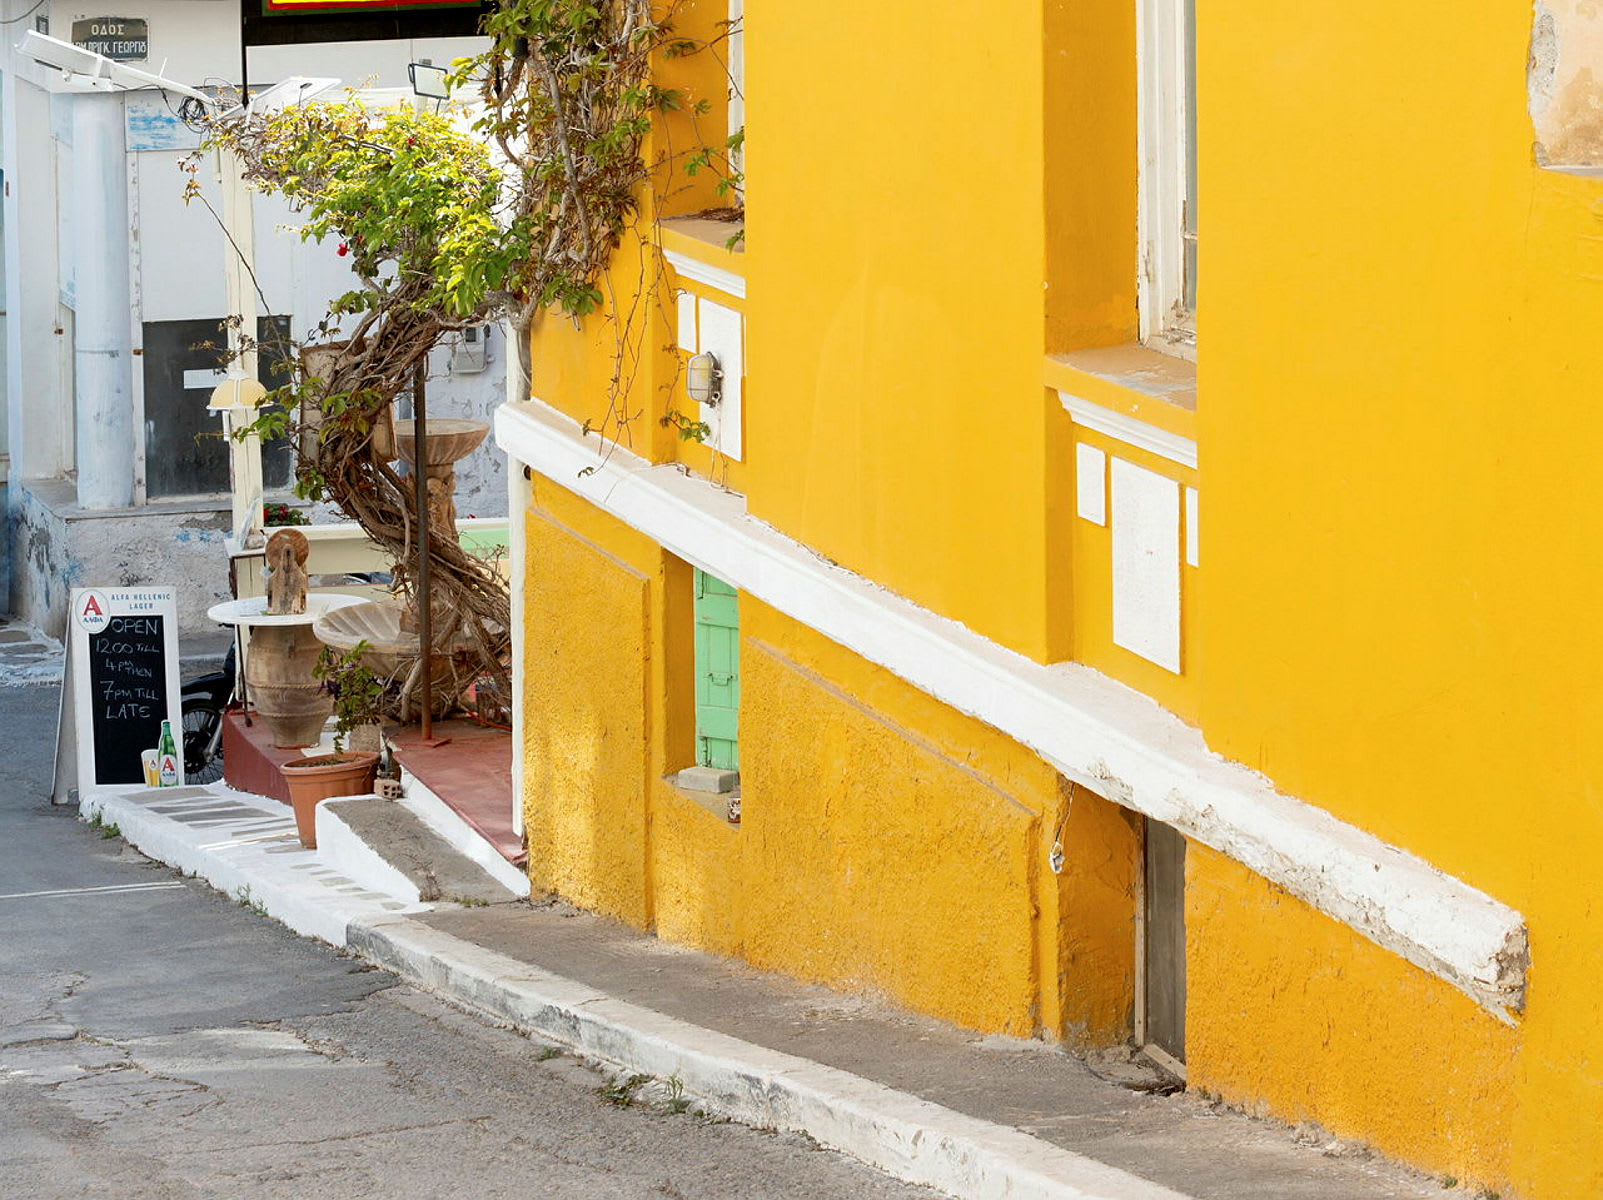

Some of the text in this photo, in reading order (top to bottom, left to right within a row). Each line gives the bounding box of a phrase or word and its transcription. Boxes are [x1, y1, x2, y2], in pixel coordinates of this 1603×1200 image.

[91, 24, 125, 36] ΟΔΟΣ
[111, 618, 158, 635] OPEN
[106, 703, 151, 719] LATE
